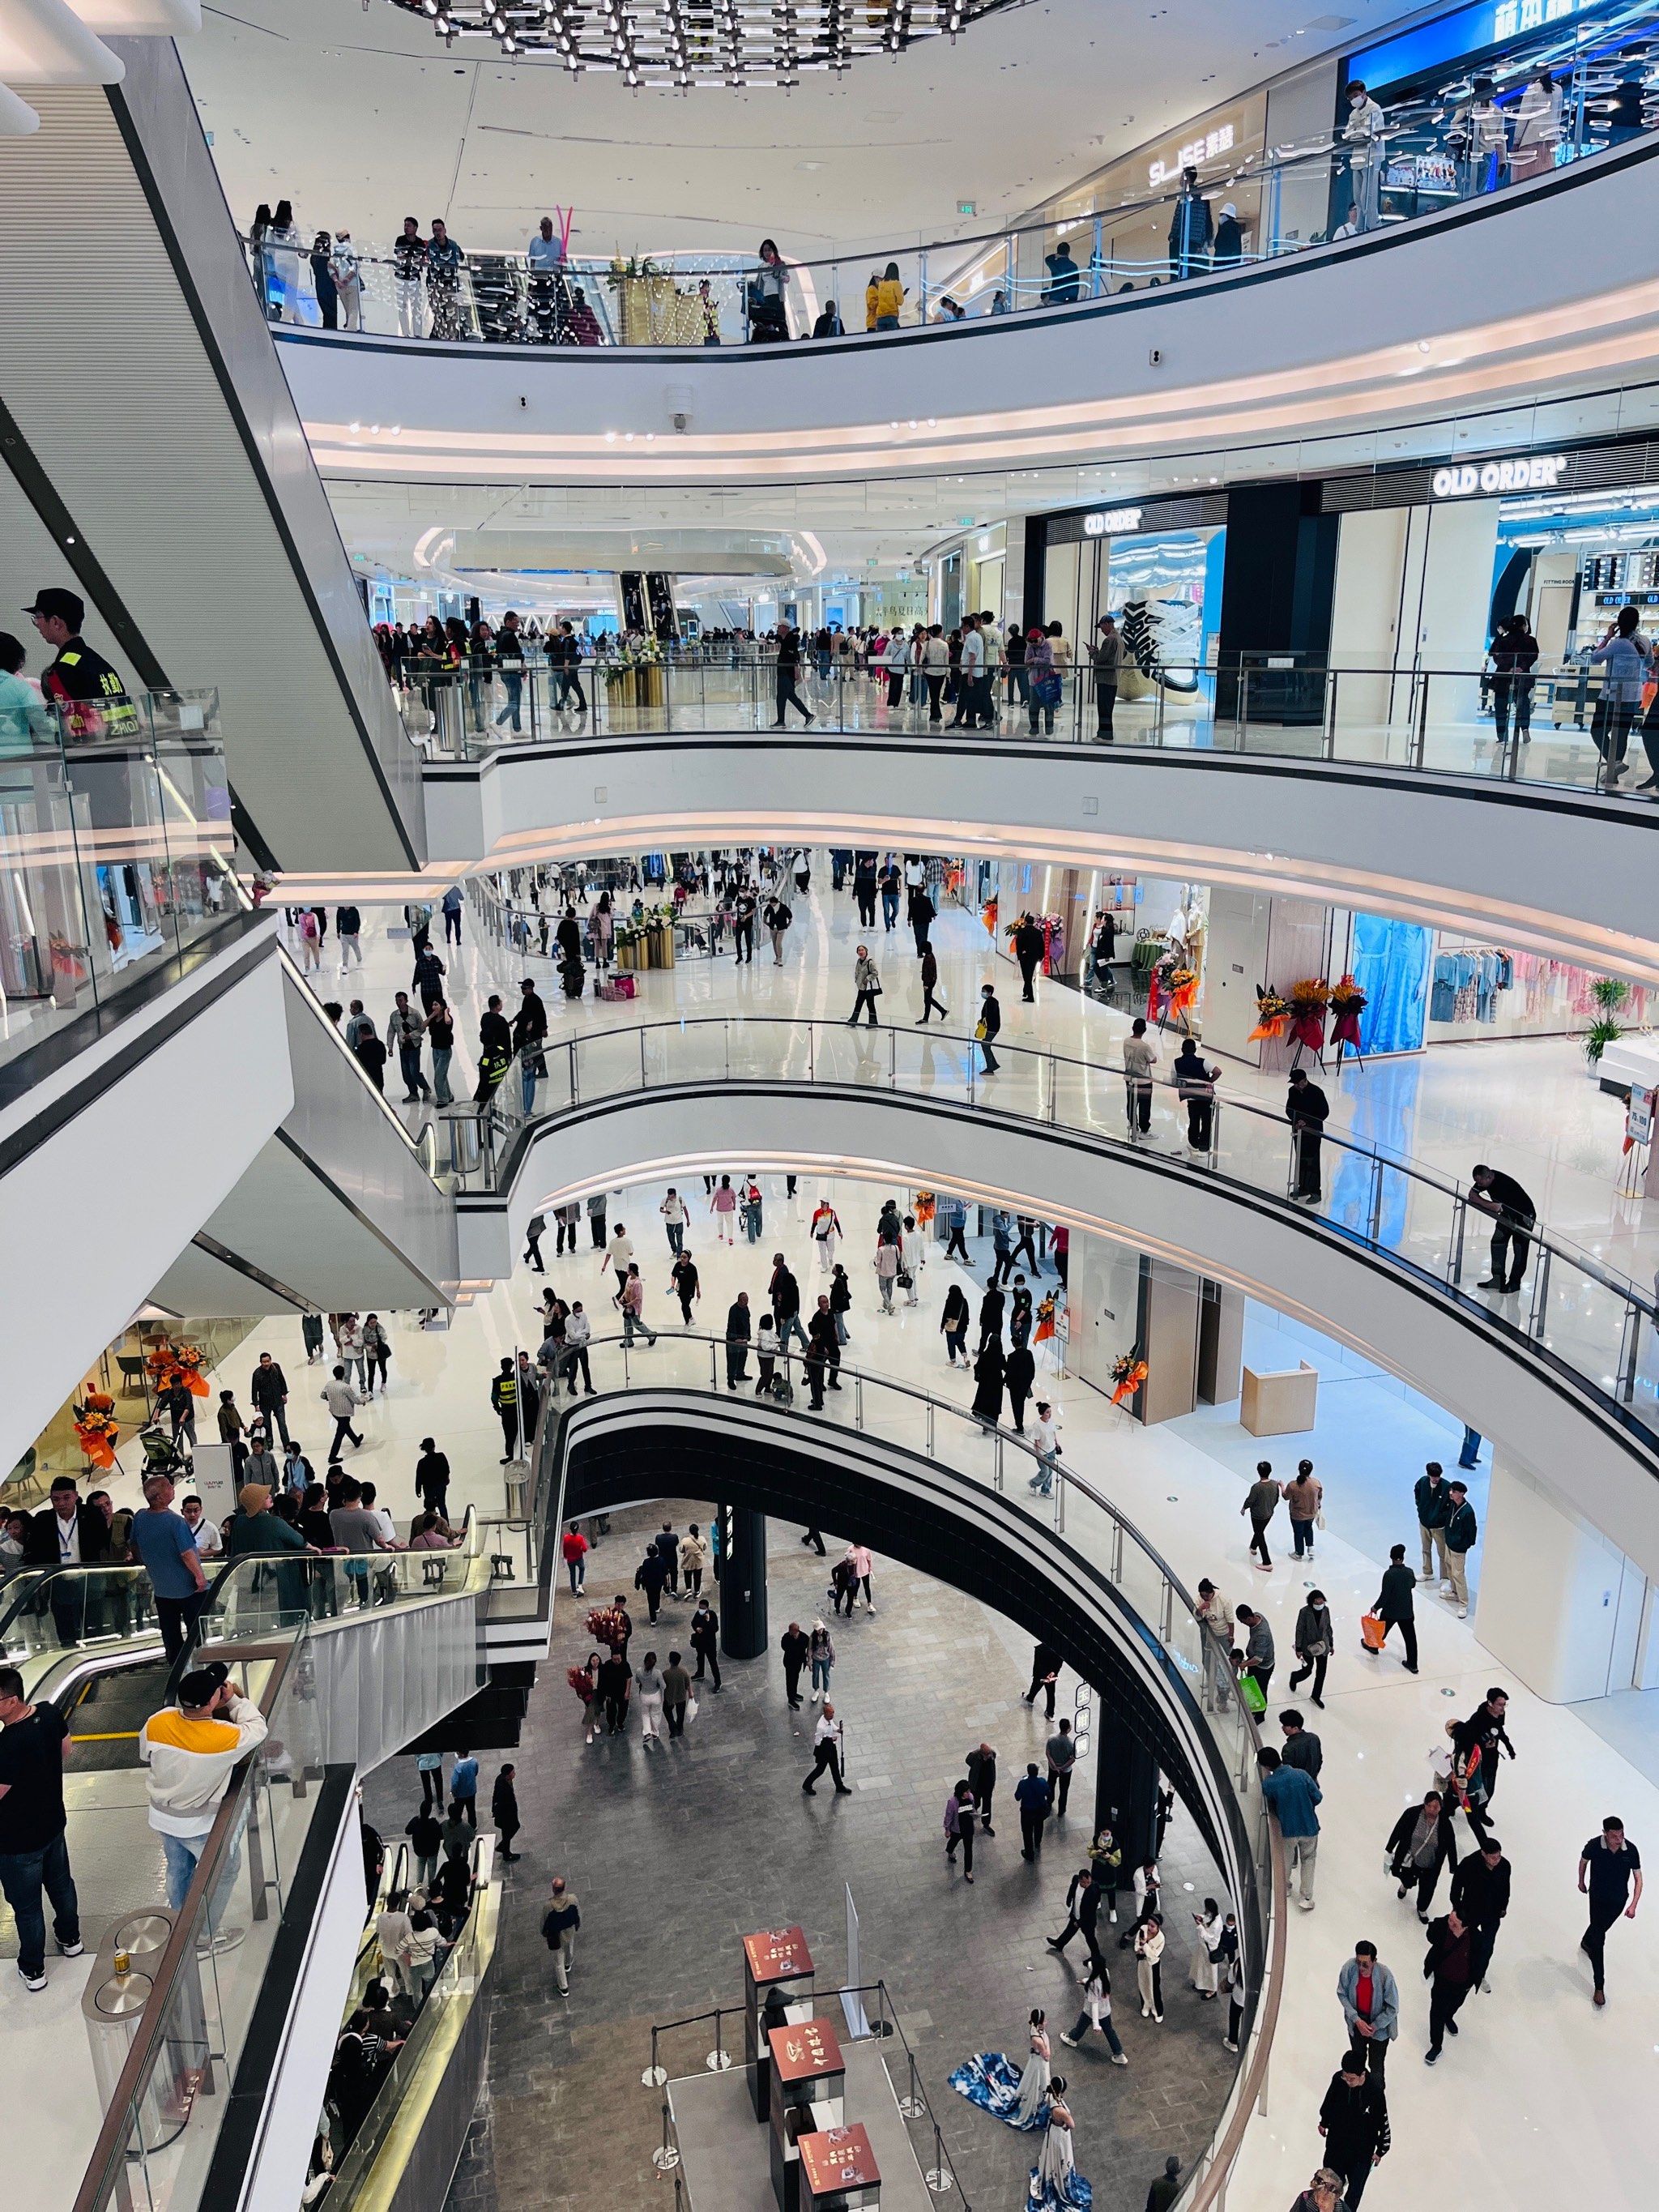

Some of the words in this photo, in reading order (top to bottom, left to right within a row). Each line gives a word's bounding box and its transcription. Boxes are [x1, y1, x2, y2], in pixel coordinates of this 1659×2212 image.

[1433, 469, 1478, 497] OLD
[1480, 456, 1559, 492] ORDER
[1085, 514, 1104, 535] OLD
[1104, 509, 1140, 532] ORDER
[876, 605, 928, 617] 太平鸟夏日高
